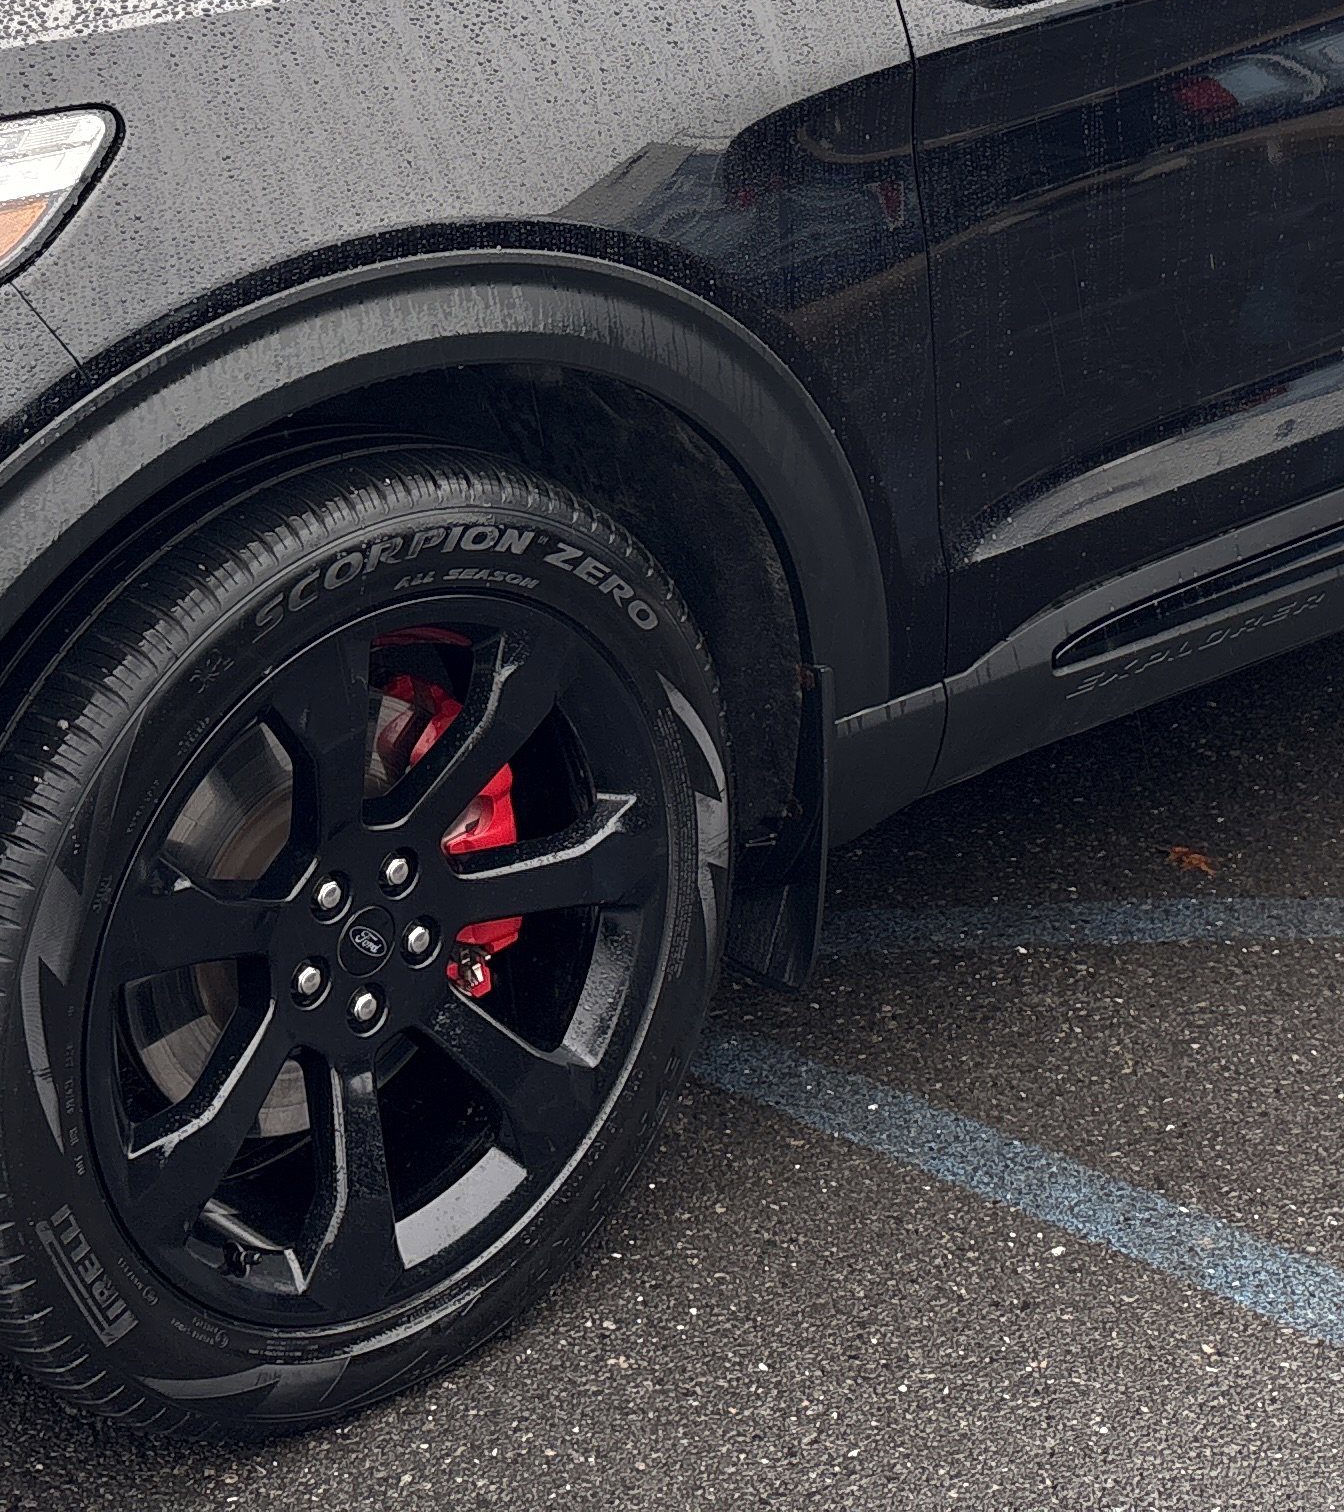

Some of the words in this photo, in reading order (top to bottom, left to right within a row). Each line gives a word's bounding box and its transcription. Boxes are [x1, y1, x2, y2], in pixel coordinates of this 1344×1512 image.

[252, 524, 538, 643] SCORPION
[543, 539, 660, 632] ZERO
[394, 569, 435, 590] ALL
[442, 567, 540, 589] SEASON
[354, 930, 382, 954] Ford
[35, 1203, 140, 1348] PIRELLI
